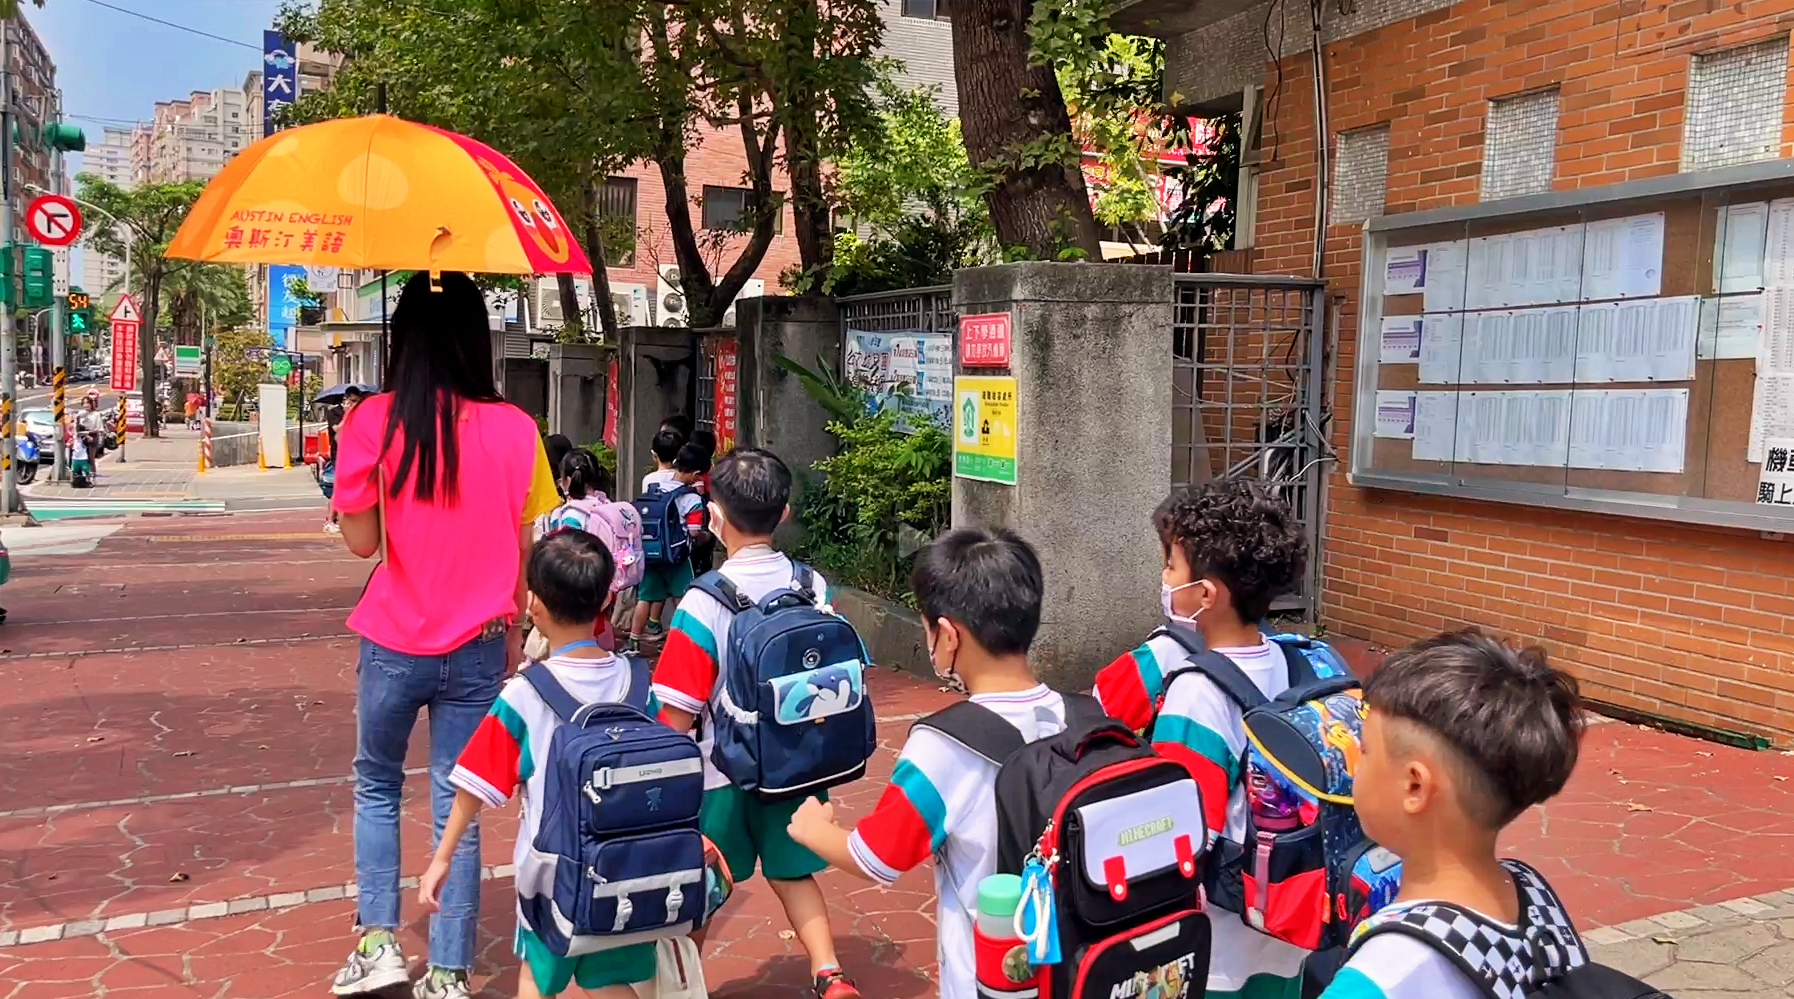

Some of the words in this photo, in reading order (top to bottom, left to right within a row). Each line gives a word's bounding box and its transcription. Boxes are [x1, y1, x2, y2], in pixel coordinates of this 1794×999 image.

[230, 210, 284, 222] AUSTIN
[289, 212, 353, 226] ENGLISH
[224, 225, 346, 253] 奧斯汀美語
[68, 293, 88, 310] 54
[1756, 481, 1794, 505] 騎上
[1119, 816, 1172, 846] MINECRAFT
